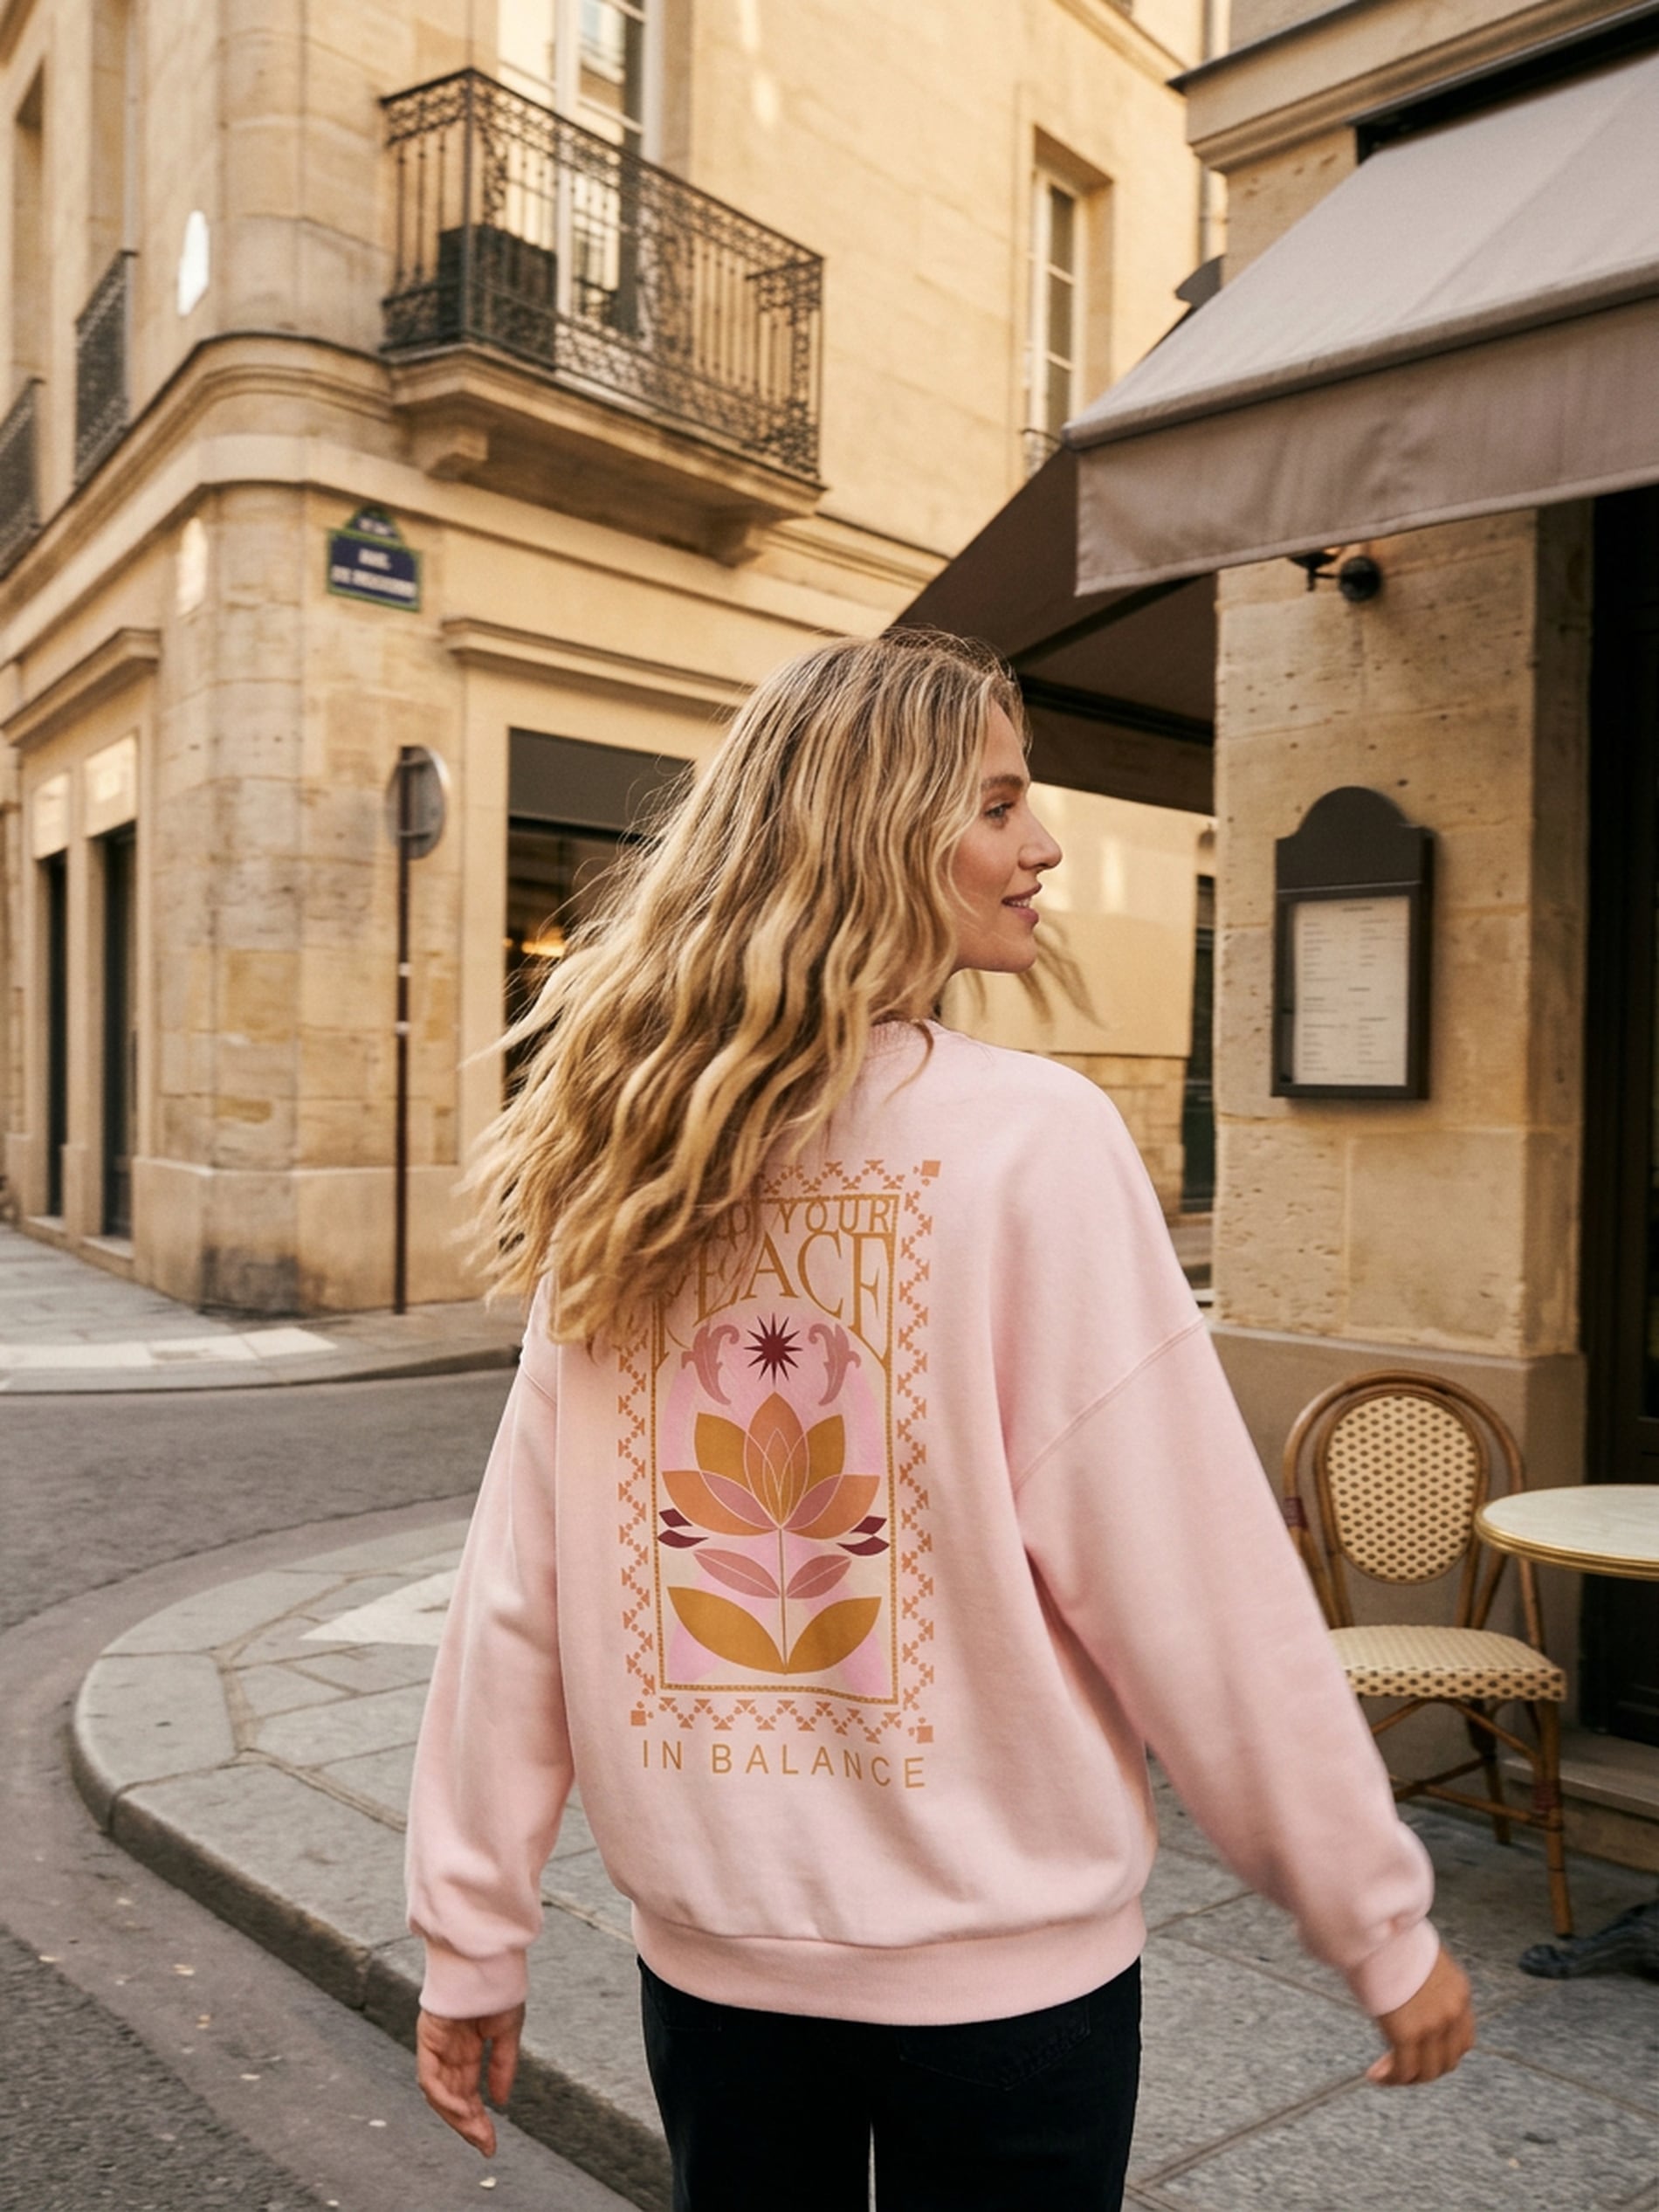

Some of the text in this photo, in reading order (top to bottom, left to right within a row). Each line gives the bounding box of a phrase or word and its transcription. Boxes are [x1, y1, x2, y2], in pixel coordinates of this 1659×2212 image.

[776, 1197, 891, 1234] YOUR
[642, 1739, 926, 1789] IN BALANCE
